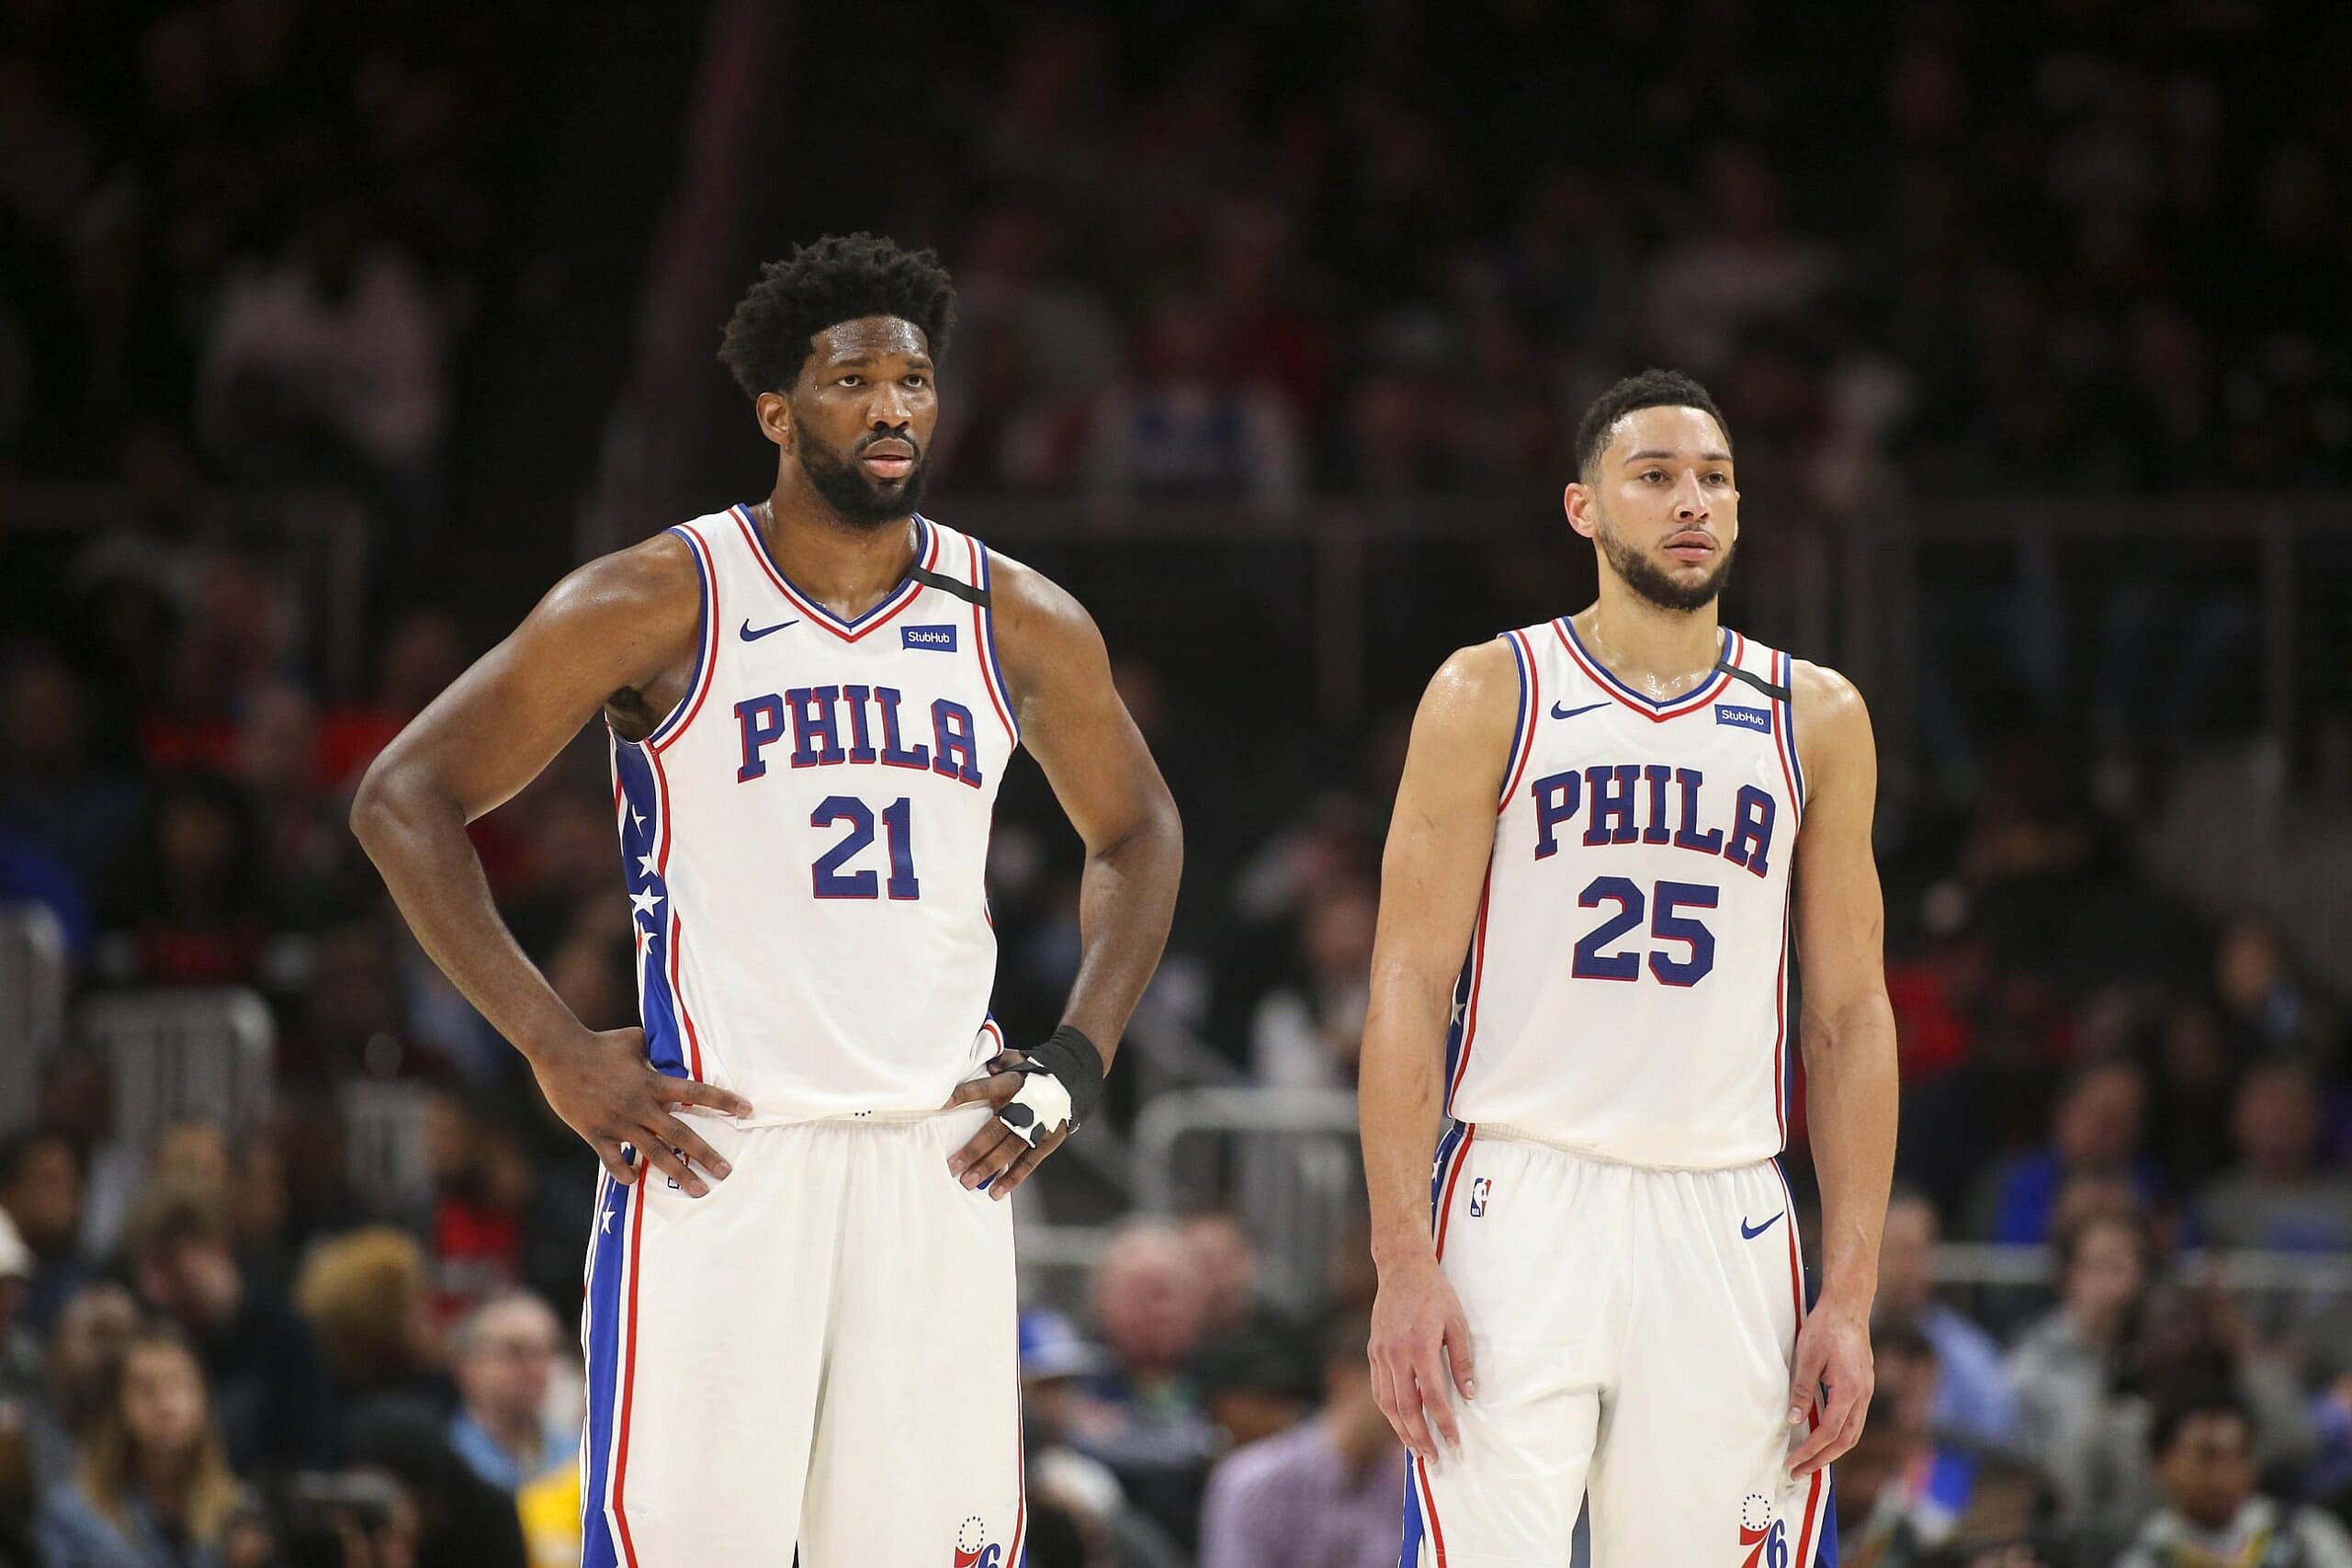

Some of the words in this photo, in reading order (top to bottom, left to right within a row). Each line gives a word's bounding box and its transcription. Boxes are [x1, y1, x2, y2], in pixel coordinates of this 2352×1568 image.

[908, 631, 950, 643] StubHub
[734, 684, 983, 789] PHILA
[1721, 709, 1765, 726] StubHub
[810, 795, 919, 900] 21
[1532, 764, 1777, 878] PHILA
[1571, 875, 1720, 987] 25
